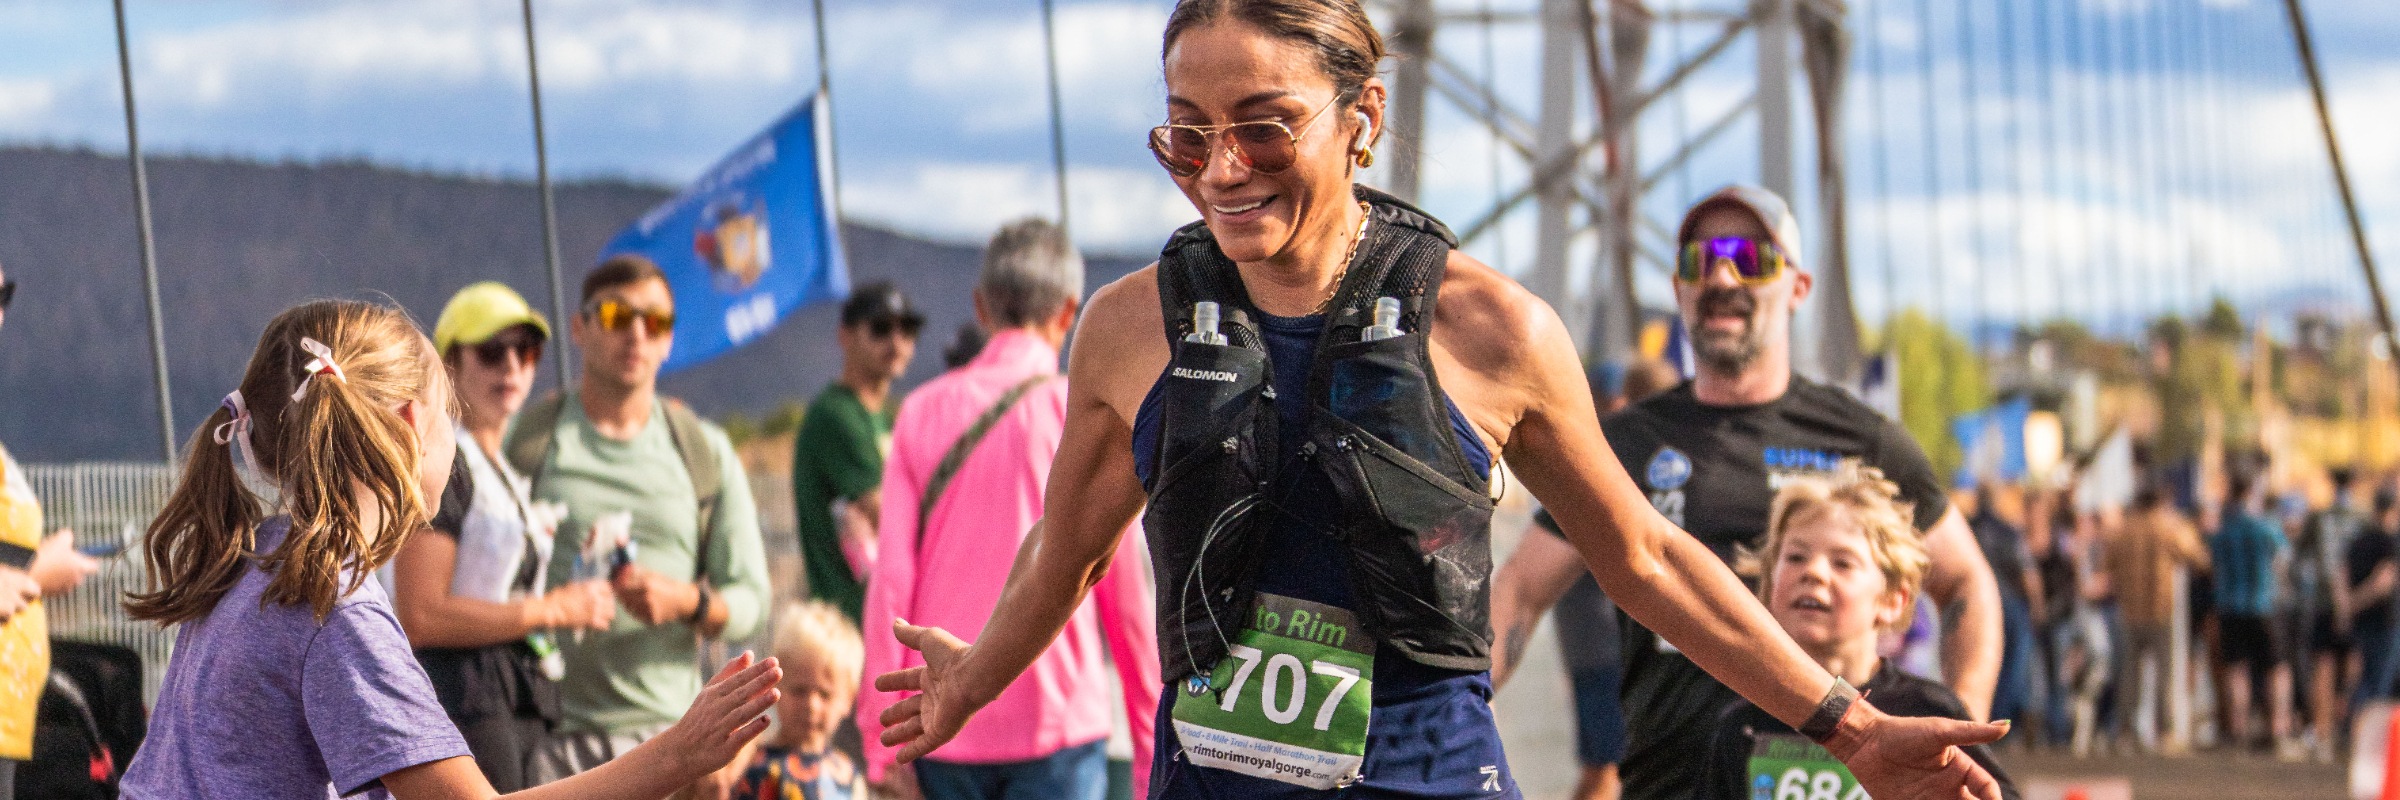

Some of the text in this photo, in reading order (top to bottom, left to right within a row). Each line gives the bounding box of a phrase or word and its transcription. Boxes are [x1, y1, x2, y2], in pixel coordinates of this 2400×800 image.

[1172, 367, 1237, 382] SALOMON
[1255, 605, 1348, 647] to Rim
[1220, 643, 1361, 731] 707
[1254, 742, 1274, 753] Half
[1274, 746, 1315, 761] Marathon
[1317, 754, 1338, 766] Trail
